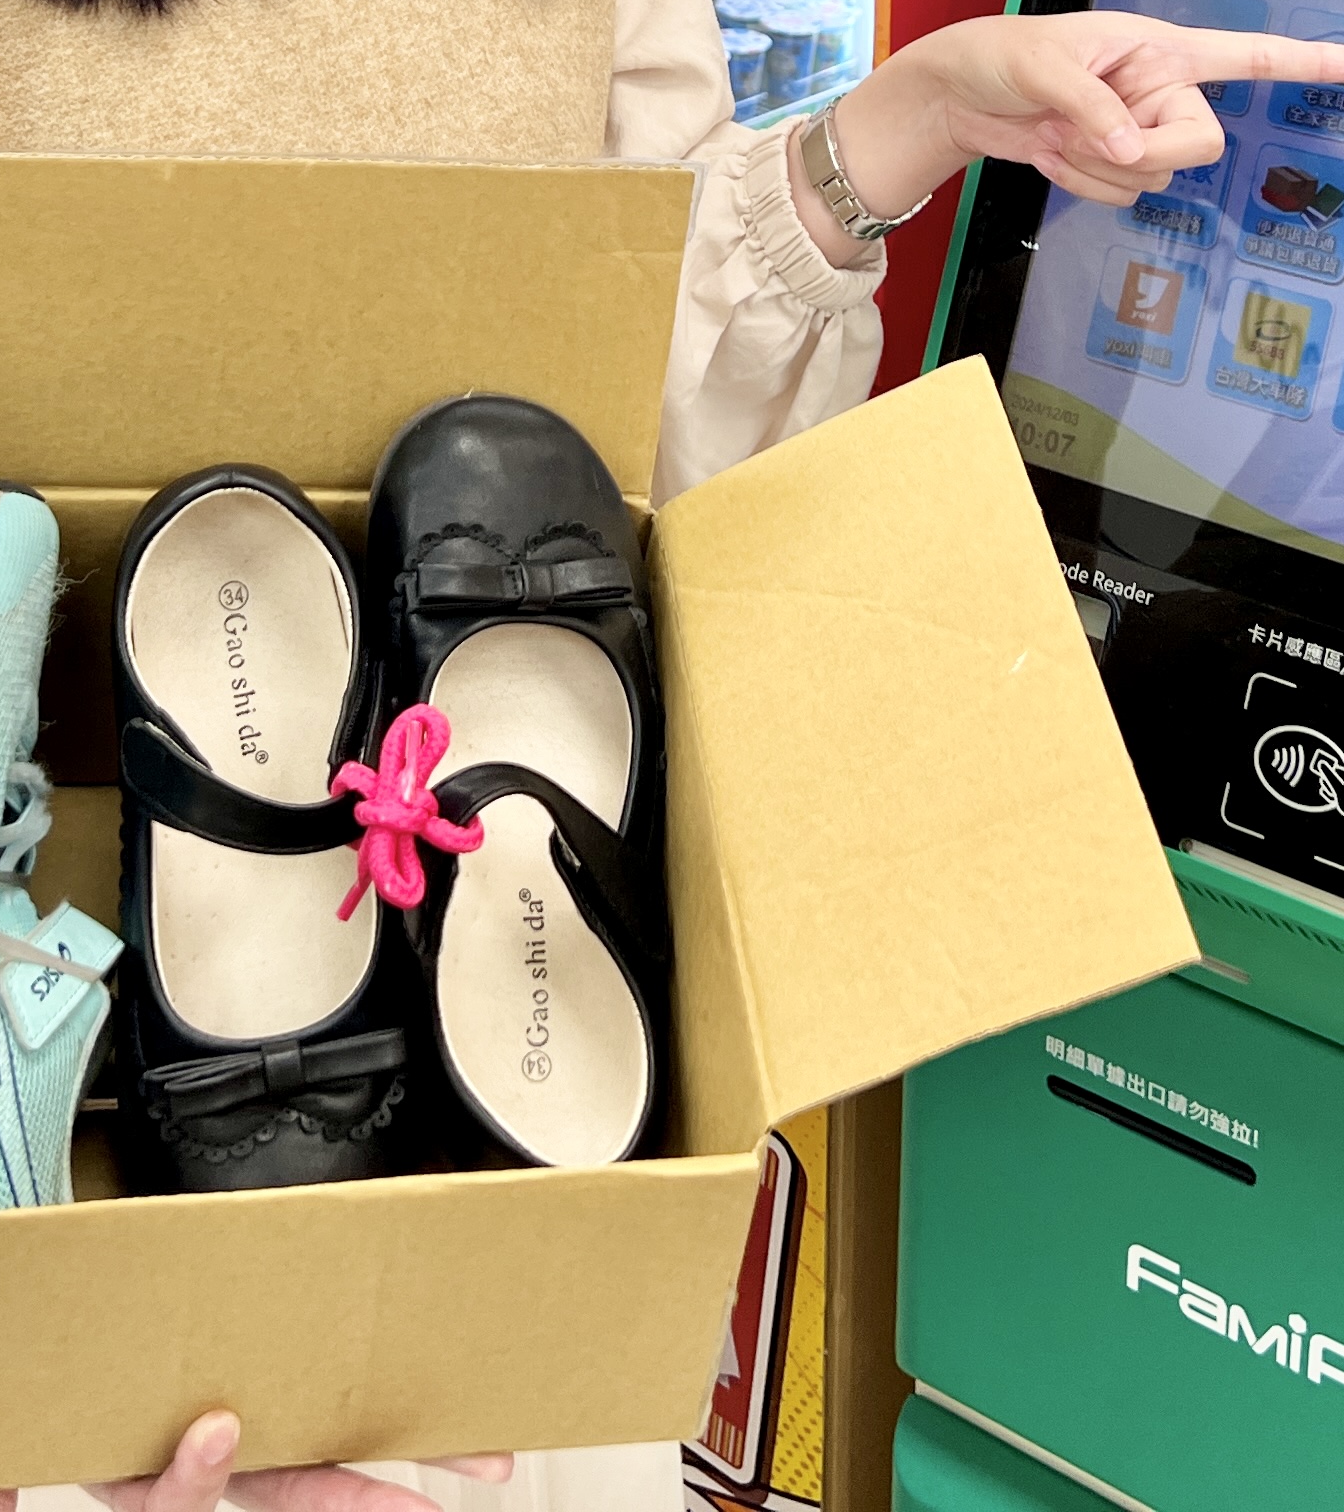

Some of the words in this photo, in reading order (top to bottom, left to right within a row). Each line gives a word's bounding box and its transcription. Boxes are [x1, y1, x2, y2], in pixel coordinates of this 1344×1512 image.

[1214, 365, 1308, 408] 台灣大車隊
[1093, 568, 1155, 608] Reader
[223, 612, 248, 669] Gao
[231, 678, 256, 717] shi
[525, 939, 548, 980] shi
[526, 988, 550, 1048] Gao
